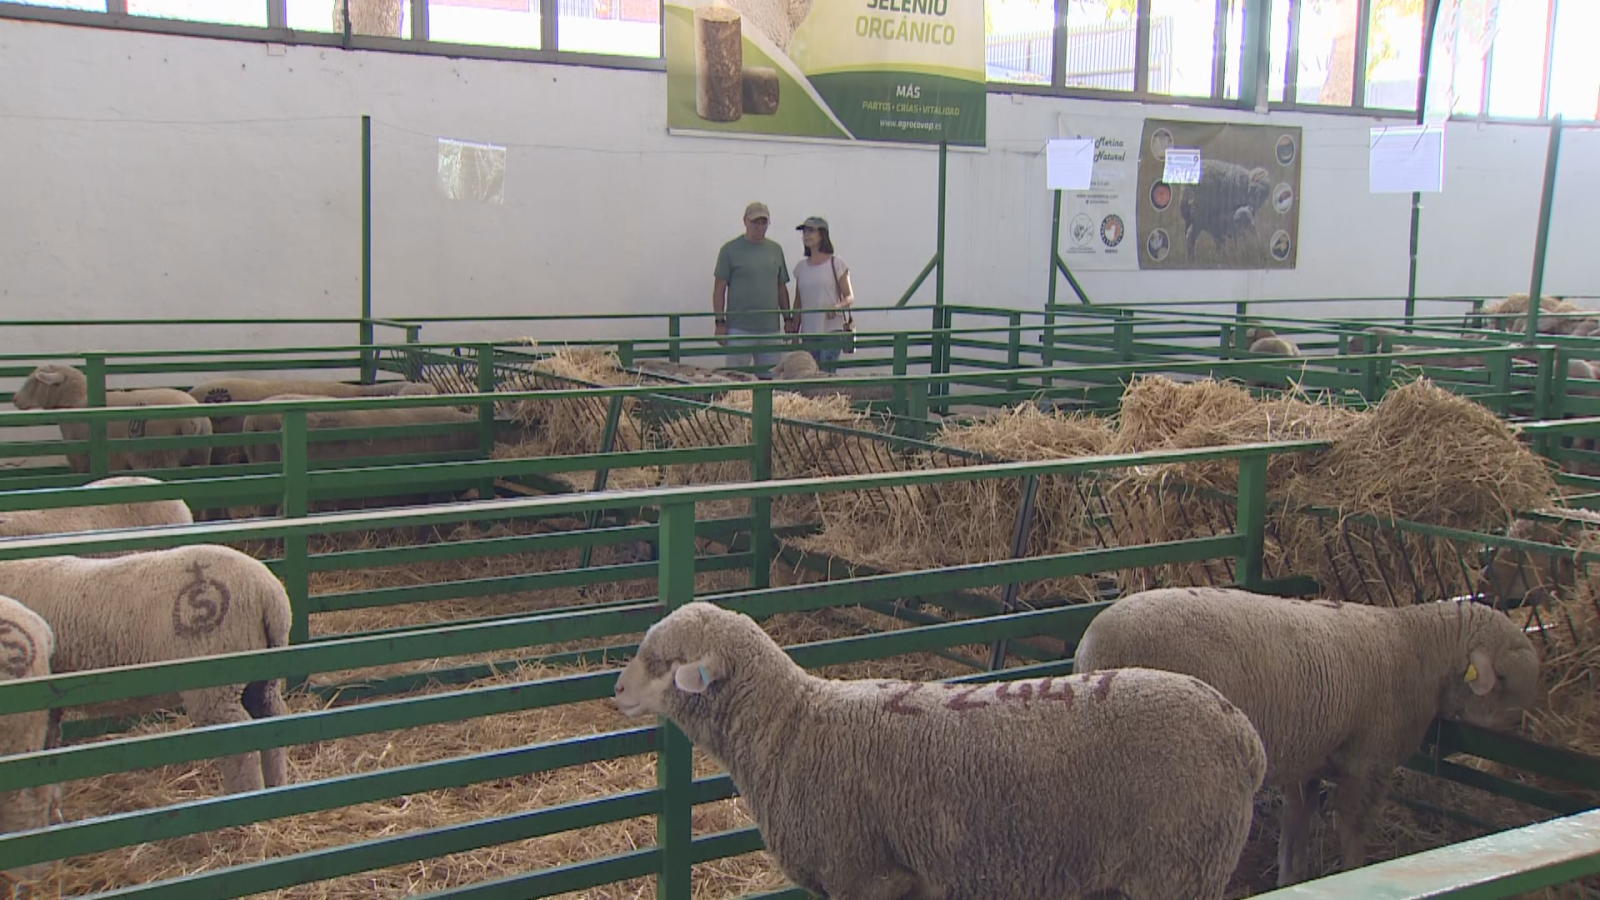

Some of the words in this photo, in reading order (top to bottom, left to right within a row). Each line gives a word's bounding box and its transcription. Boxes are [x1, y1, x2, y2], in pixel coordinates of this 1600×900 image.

[855, 15, 956, 46] ORGÁNICO
[896, 83, 921, 99] MÁS
[862, 101, 891, 112] PARTOS
[896, 100, 919, 114] CRÍAS
[923, 105, 960, 116] VITALIDAD
[879, 118, 942, 132] www.agrocovap.es
[1094, 136, 1124, 149] Merina
[1093, 150, 1126, 163] Natural
